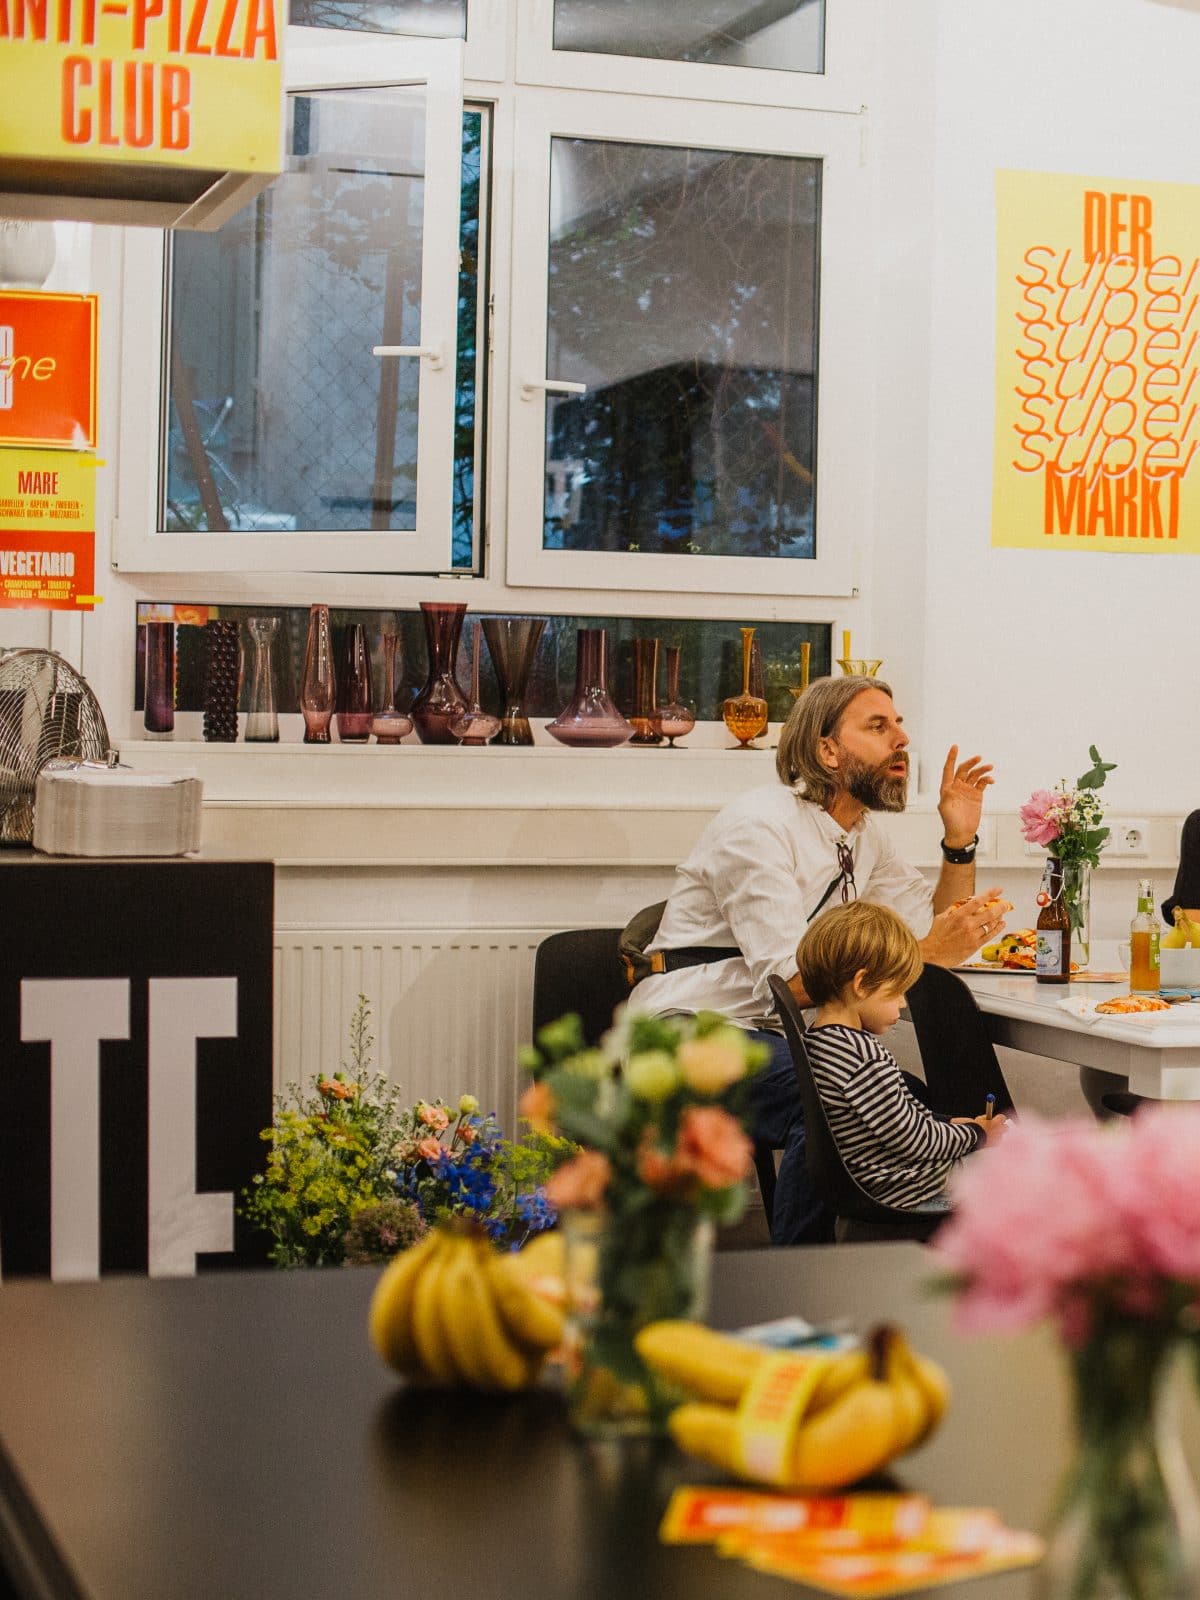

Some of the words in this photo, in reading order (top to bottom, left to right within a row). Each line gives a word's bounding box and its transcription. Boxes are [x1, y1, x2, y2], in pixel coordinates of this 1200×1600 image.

[0, 0, 278, 61] I-PIZZA
[61, 54, 191, 151] CLUB
[1083, 190, 1153, 268] DER
[18, 471, 58, 495] MARE
[1044, 460, 1185, 539] MARKT
[0, 551, 75, 577] VEGETARIO
